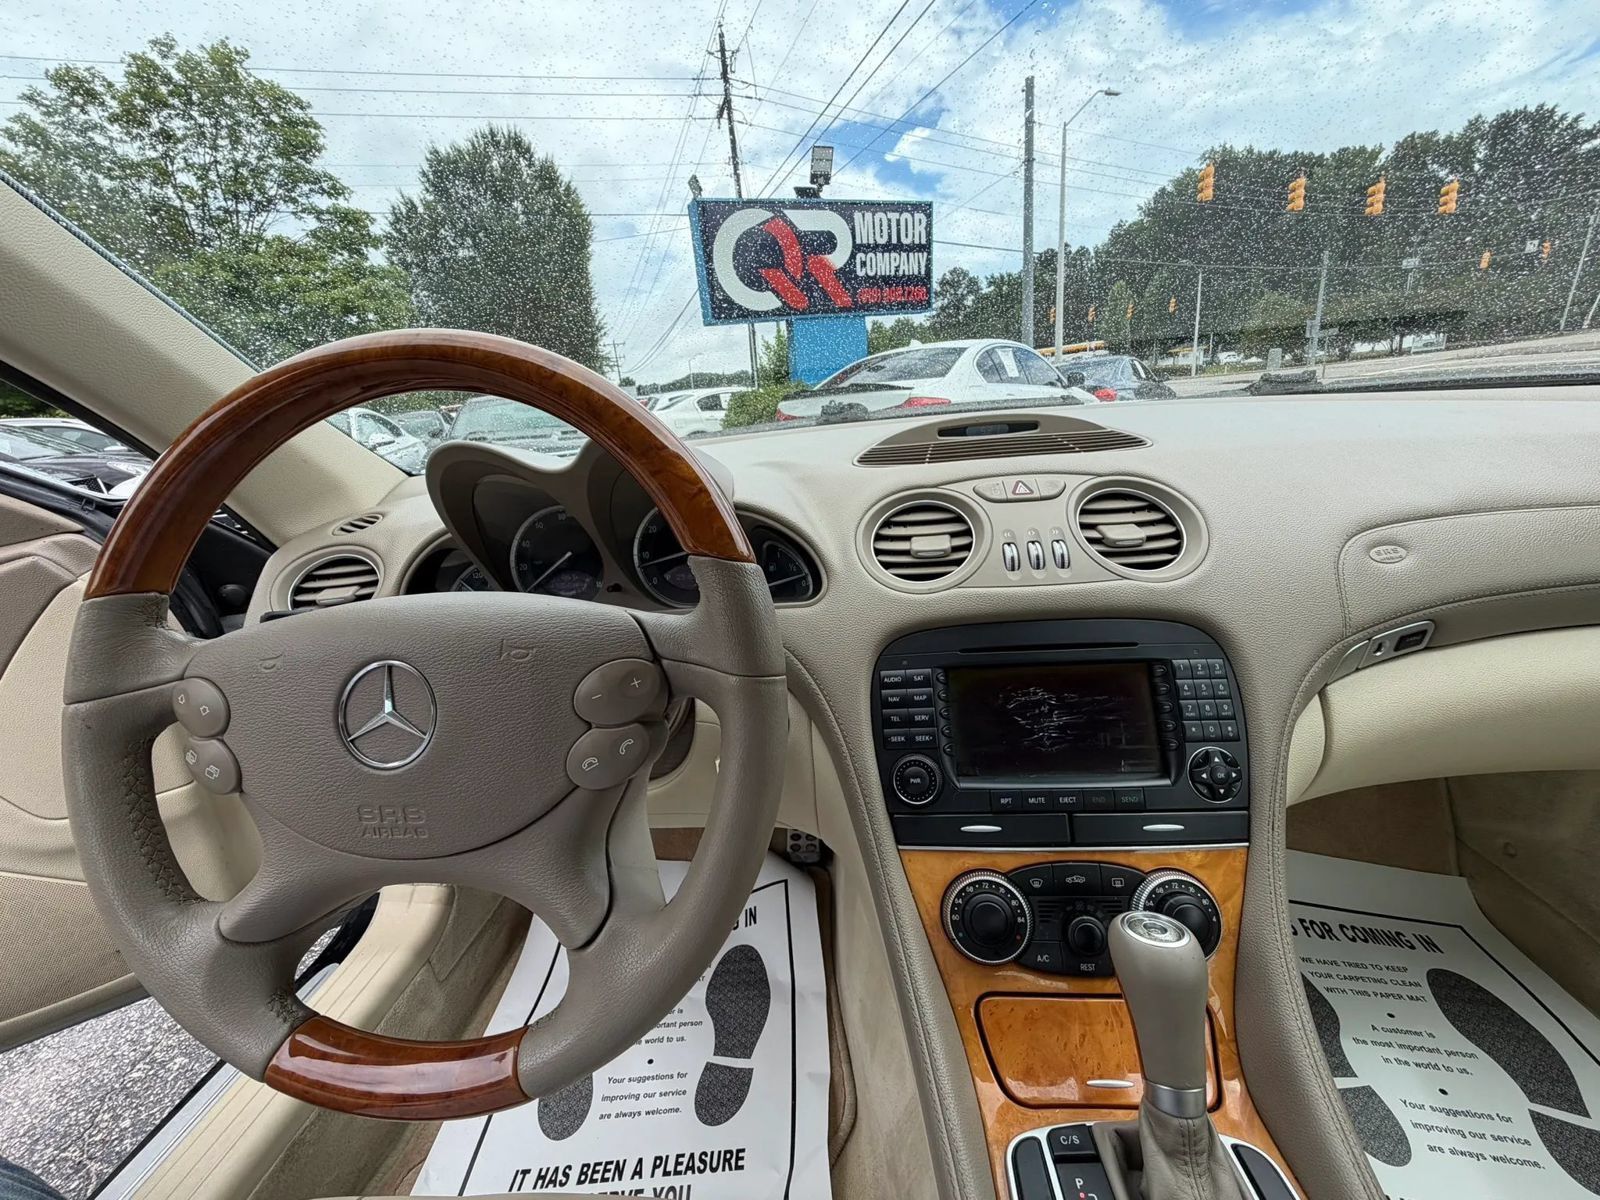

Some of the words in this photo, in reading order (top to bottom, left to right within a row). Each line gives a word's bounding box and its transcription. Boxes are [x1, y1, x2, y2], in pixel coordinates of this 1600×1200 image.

[854, 211, 927, 244] MOTOR
[856, 252, 928, 277] COMPANY
[1059, 796, 1077, 804] EJECT
[357, 804, 426, 825] SRS
[361, 826, 429, 839] AIRBAG
[1201, 898, 1210, 906] 80
[745, 905, 757, 928] IN
[1297, 917, 1342, 942] FOR
[1338, 923, 1417, 951] COMING
[1412, 933, 1445, 955] IN
[1036, 954, 1050, 962] A/C
[1080, 963, 1096, 971] REST
[1300, 955, 1313, 964] WE
[1315, 957, 1341, 967] HAVE
[1340, 960, 1368, 971] TRIED
[1368, 963, 1383, 971] TO
[1384, 964, 1409, 974] KEEP
[1307, 970, 1335, 980] YOUR
[1336, 973, 1389, 985] CARPETING
[1389, 978, 1423, 989] CLEAN
[1323, 985, 1348, 995] WITH
[1349, 988, 1372, 998] THIS
[1373, 991, 1405, 1002] PAPER
[1405, 995, 1428, 1003] MAT
[656, 1021, 677, 1029] ortant
[678, 1020, 703, 1029] person
[1370, 1023, 1380, 1033] A
[1381, 1026, 1425, 1038] customer
[1424, 1030, 1437, 1039] is
[645, 1035, 665, 1044] world
[666, 1035, 674, 1043] to
[1352, 1036, 1369, 1046] the
[1370, 1039, 1396, 1049] most
[1396, 1041, 1443, 1055] important
[1443, 1048, 1479, 1060] person
[1381, 1055, 1393, 1065] in
[1394, 1057, 1412, 1067] the
[1412, 1061, 1442, 1072] world
[1441, 1063, 1455, 1073] to
[1456, 1066, 1474, 1076] us.
[607, 1076, 626, 1084] Your
[628, 1073, 674, 1084] suggestions
[677, 1071, 688, 1079] for
[601, 1092, 640, 1103] improving
[643, 1091, 657, 1099] our
[659, 1088, 687, 1098] service
[599, 1112, 612, 1120] are
[614, 1110, 642, 1120] always
[645, 1107, 682, 1116] welcome.
[1399, 1098, 1427, 1111] Your
[1428, 1103, 1496, 1122] suggestions
[1495, 1112, 1514, 1124] for
[1060, 1135, 1080, 1144] C/S
[1410, 1119, 1467, 1139] improving
[1468, 1130, 1489, 1141] our
[1489, 1132, 1532, 1147] service
[1426, 1143, 1446, 1154] are
[1448, 1146, 1487, 1162] always
[1489, 1153, 1547, 1170] welcome.
[508, 1168, 531, 1193] IT
[532, 1164, 573, 1190] HAS
[576, 1158, 627, 1185] BEEN
[630, 1157, 644, 1181] A
[650, 1148, 746, 1179] PLEASURE
[1075, 1177, 1084, 1190] P
